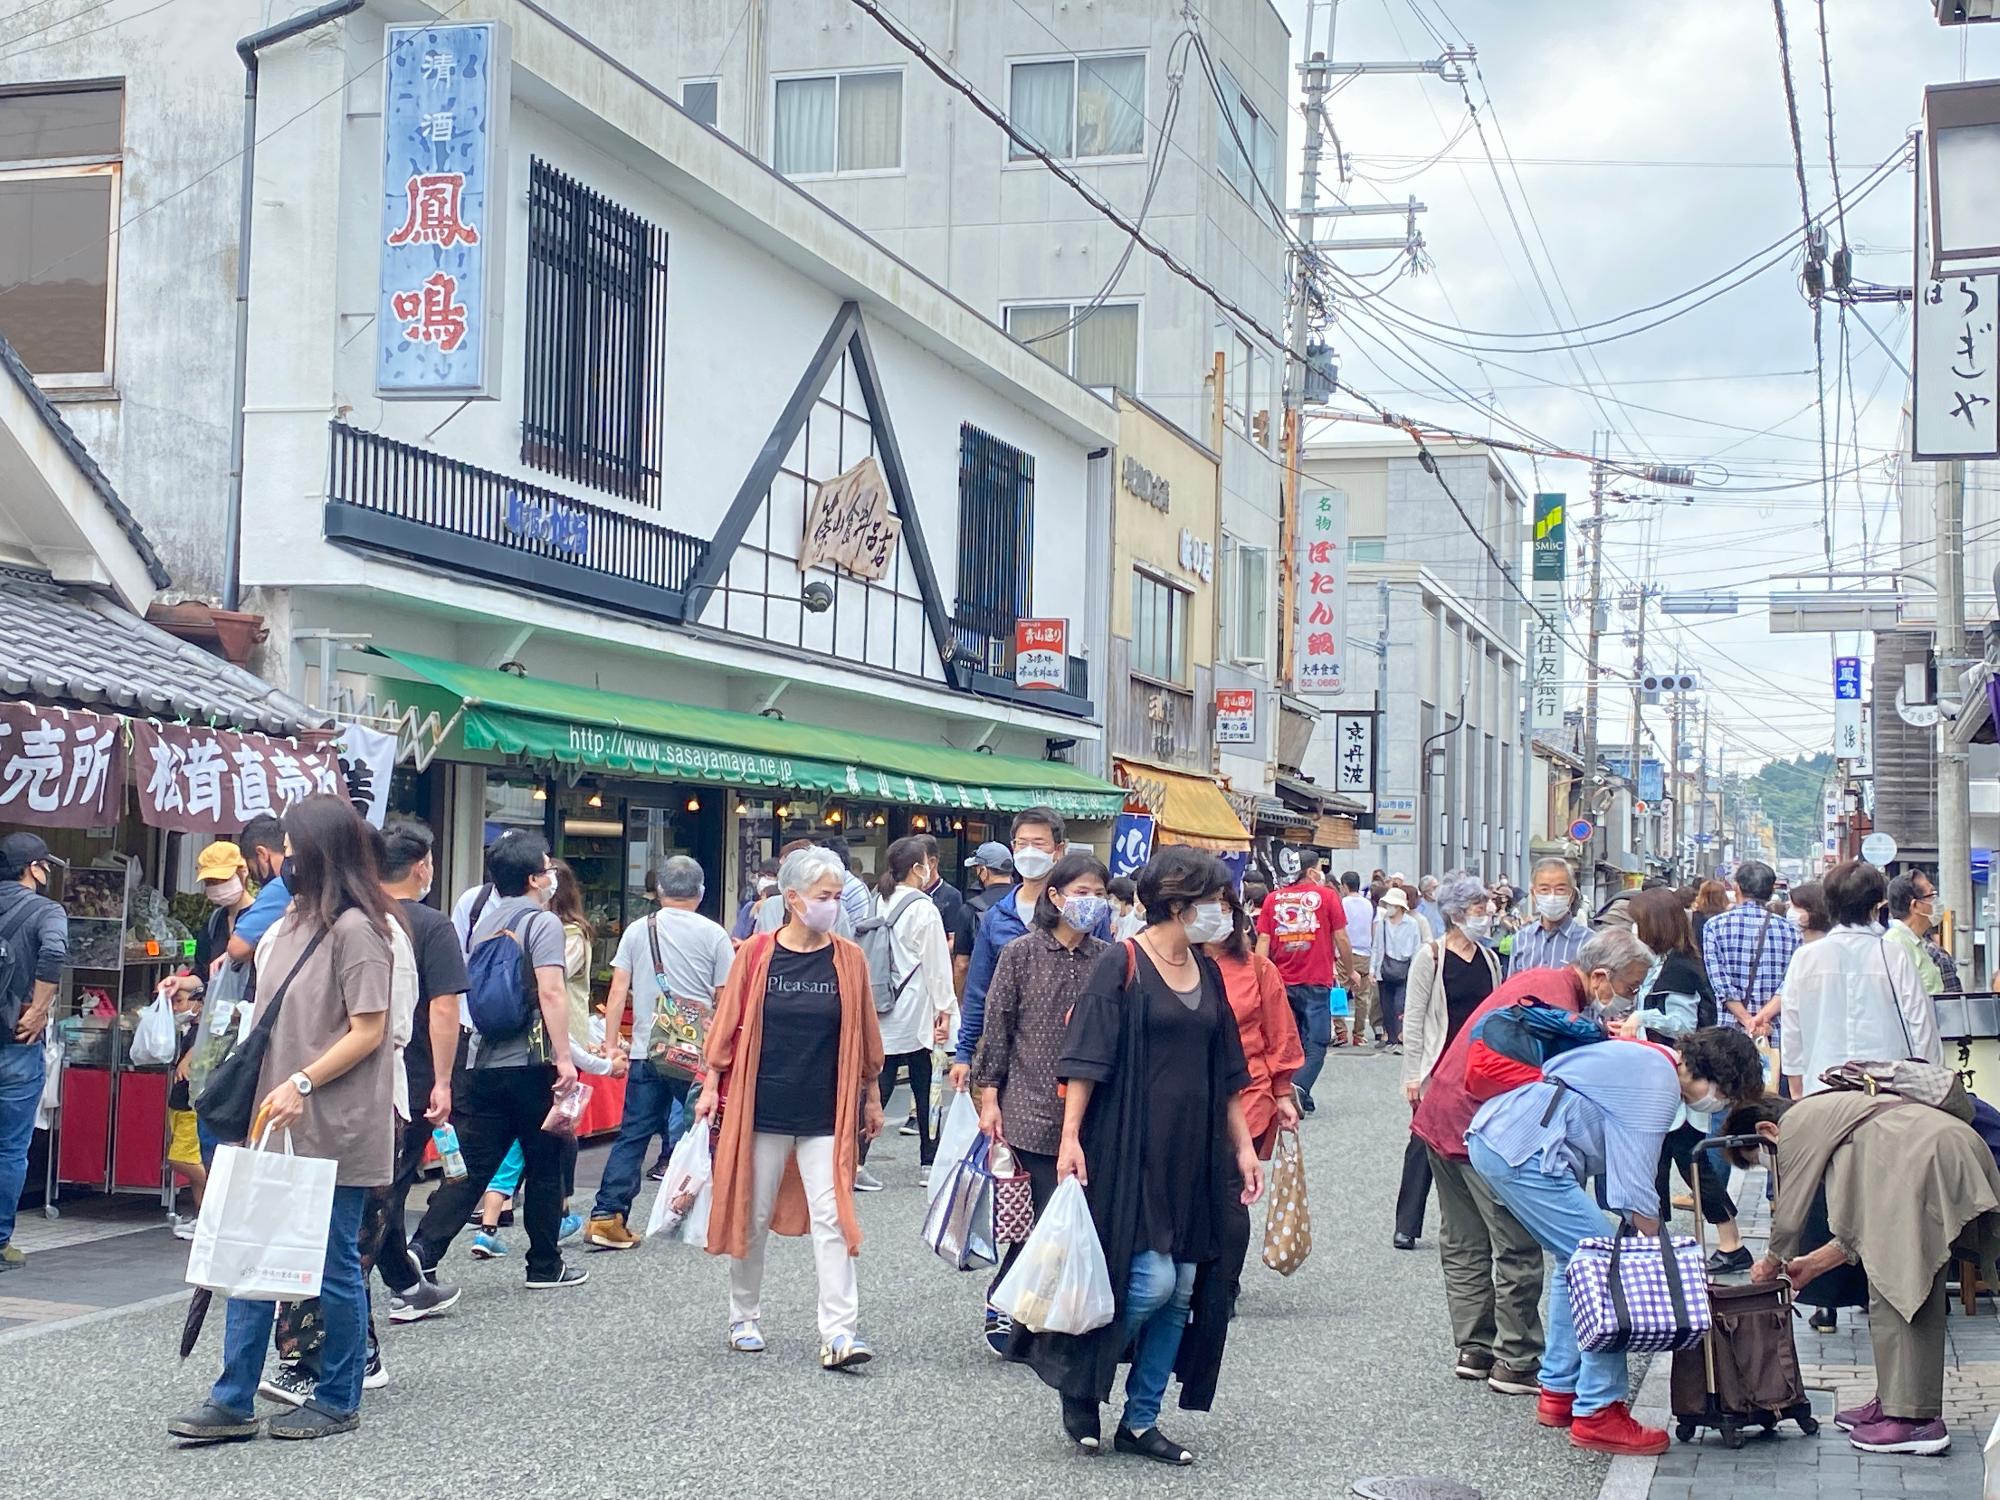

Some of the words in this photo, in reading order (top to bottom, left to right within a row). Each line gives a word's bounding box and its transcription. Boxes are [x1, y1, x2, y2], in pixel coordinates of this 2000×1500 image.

[421, 53, 457, 141] 清酒
[387, 173, 481, 353] 鳳鳴
[1315, 496, 1332, 531] 名物
[1308, 540, 1336, 656] ぼたん鍋
[1302, 663, 1340, 676] 大手食堂
[1537, 593, 1557, 716] 三井住友銀行
[0, 718, 115, 813] 売所
[147, 735, 338, 823] 松茸直売所
[569, 724, 793, 782] http://www.sasayamaya.ne.jp
[1344, 721, 1365, 784] 京丹波
[767, 974, 838, 994] Pleasant
